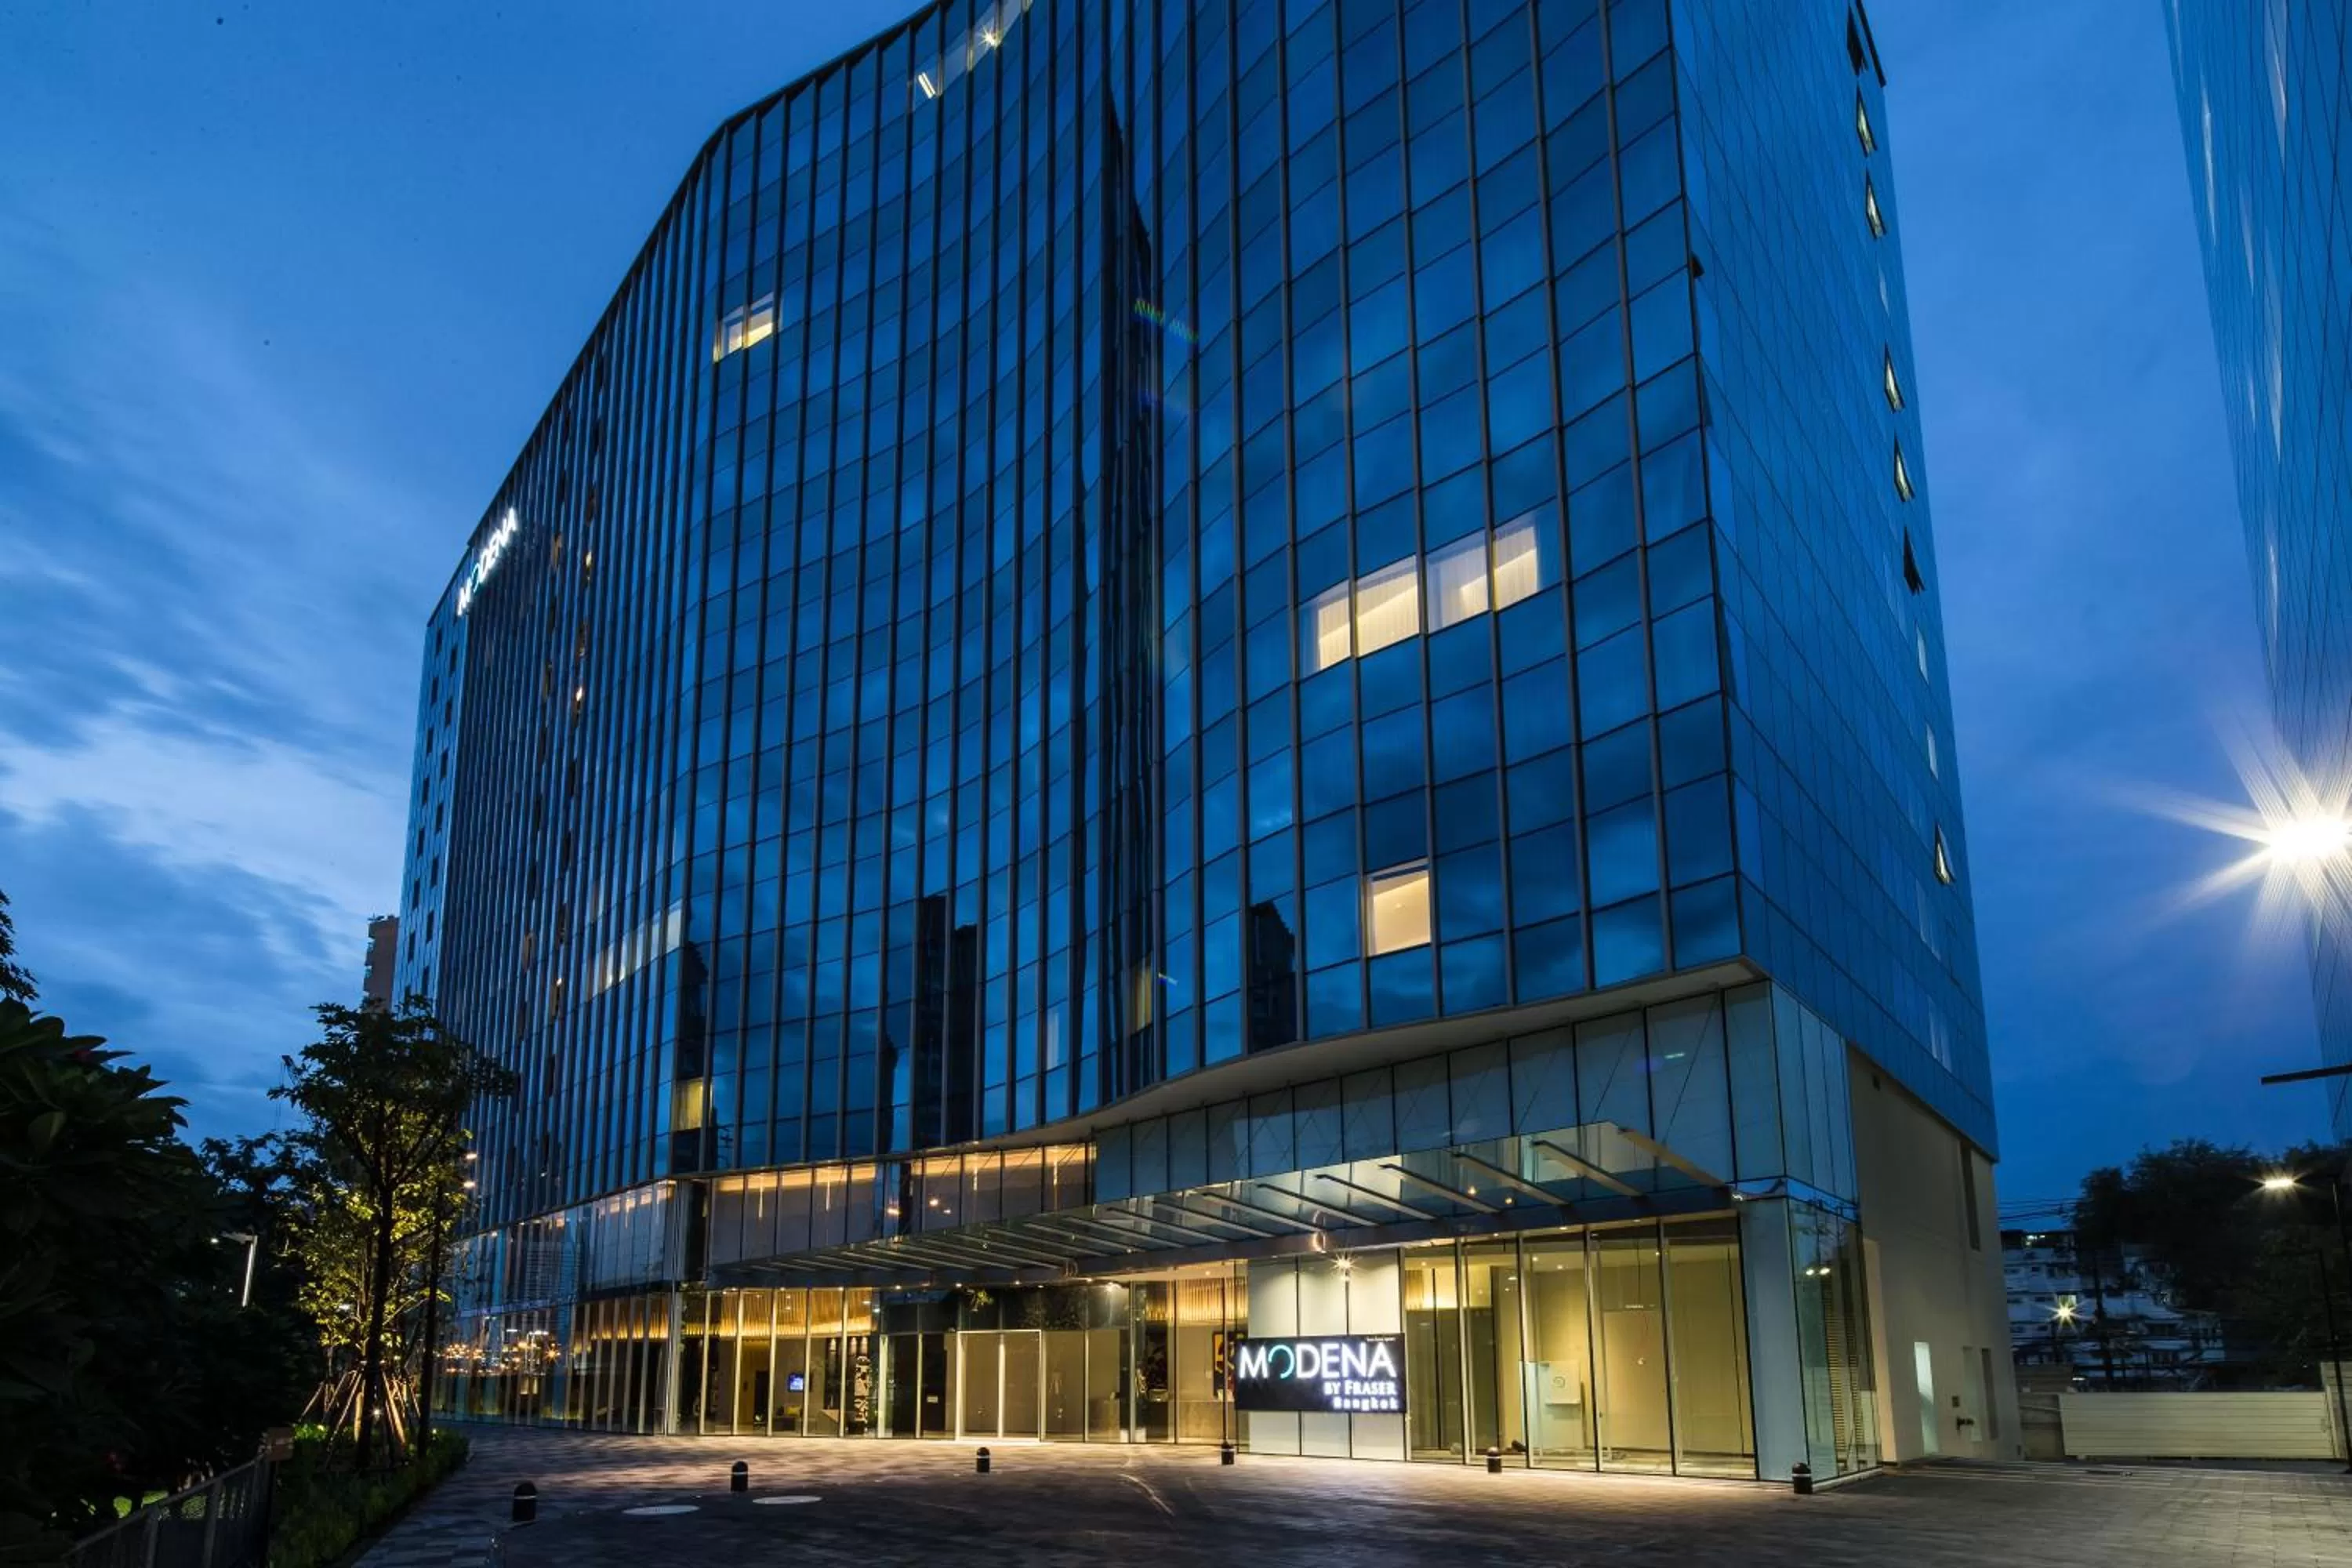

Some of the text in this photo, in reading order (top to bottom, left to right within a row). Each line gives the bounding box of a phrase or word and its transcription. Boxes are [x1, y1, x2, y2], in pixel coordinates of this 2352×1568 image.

[1238, 1341, 1397, 1379] MODENA
[1324, 1380, 1397, 1396] BY FRASER
[1334, 1396, 1399, 1411] Bangkok
